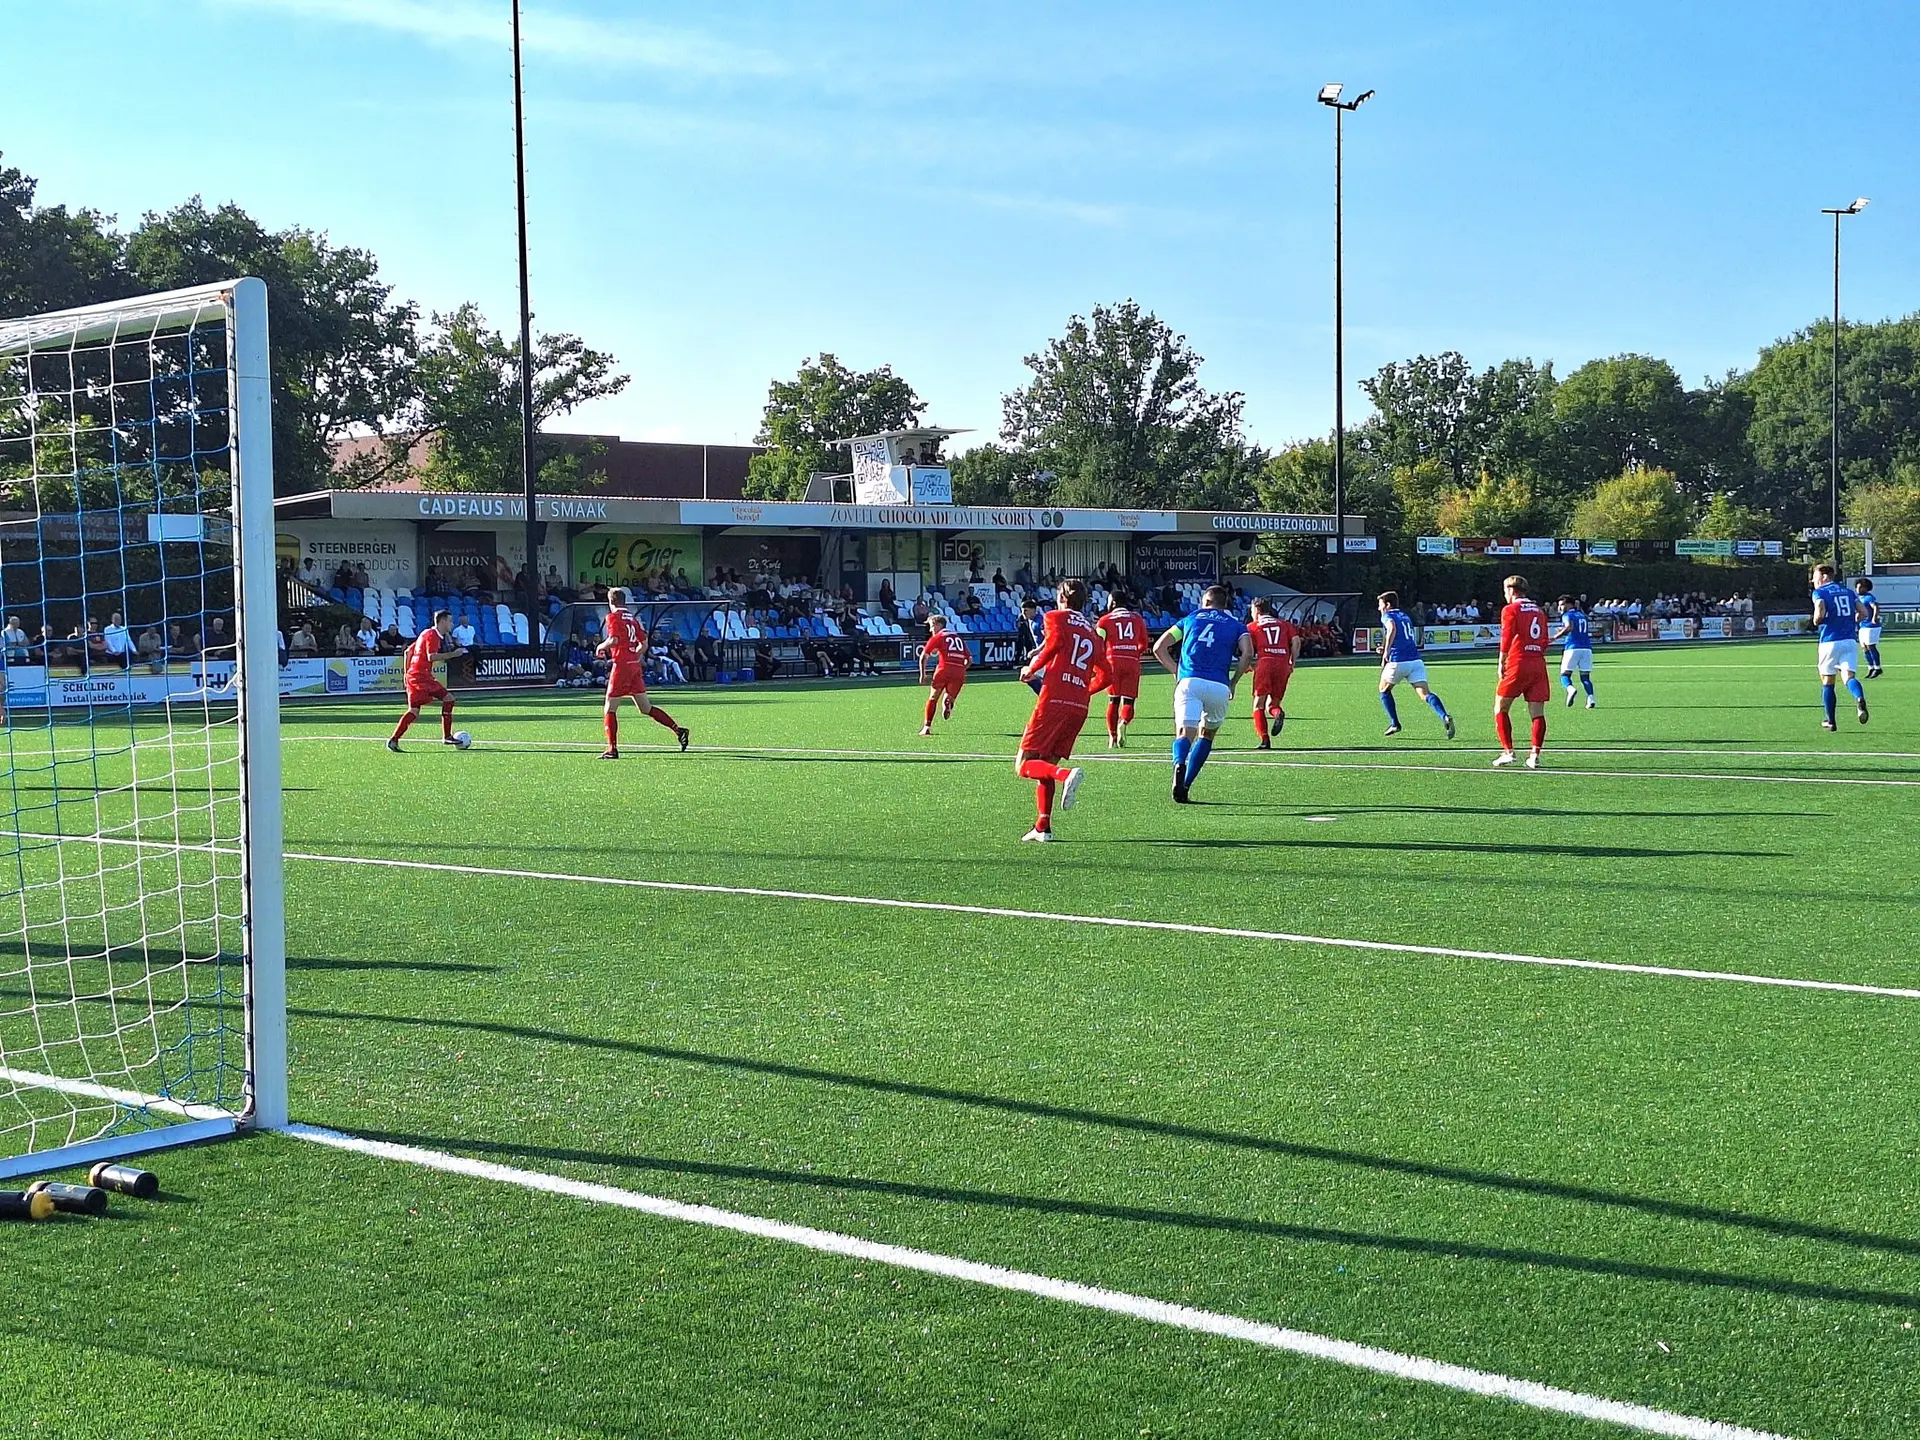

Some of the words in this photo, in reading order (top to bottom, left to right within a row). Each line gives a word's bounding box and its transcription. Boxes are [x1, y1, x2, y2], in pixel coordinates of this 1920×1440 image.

[418, 497, 504, 517] CADEAUS
[510, 500, 545, 518] MT
[550, 501, 608, 519] SMAAK
[829, 509, 877, 523] ZOVEEL
[878, 509, 951, 525] CHOCOLADE
[1212, 515, 1334, 532] CHOCOLADEBEZORGD.NL
[308, 542, 397, 555] STEENBERGEN
[591, 538, 618, 569] de
[1153, 546, 1198, 557] Autoschade
[429, 555, 490, 567] MARRON
[1833, 595, 1851, 617] 19
[1115, 621, 1135, 640] 14
[1197, 623, 1215, 648] 4
[1262, 625, 1281, 645] 17
[1529, 616, 1541, 640] 6
[945, 637, 965, 652] 20
[1070, 632, 1094, 671] 12
[351, 657, 387, 667] Totaal
